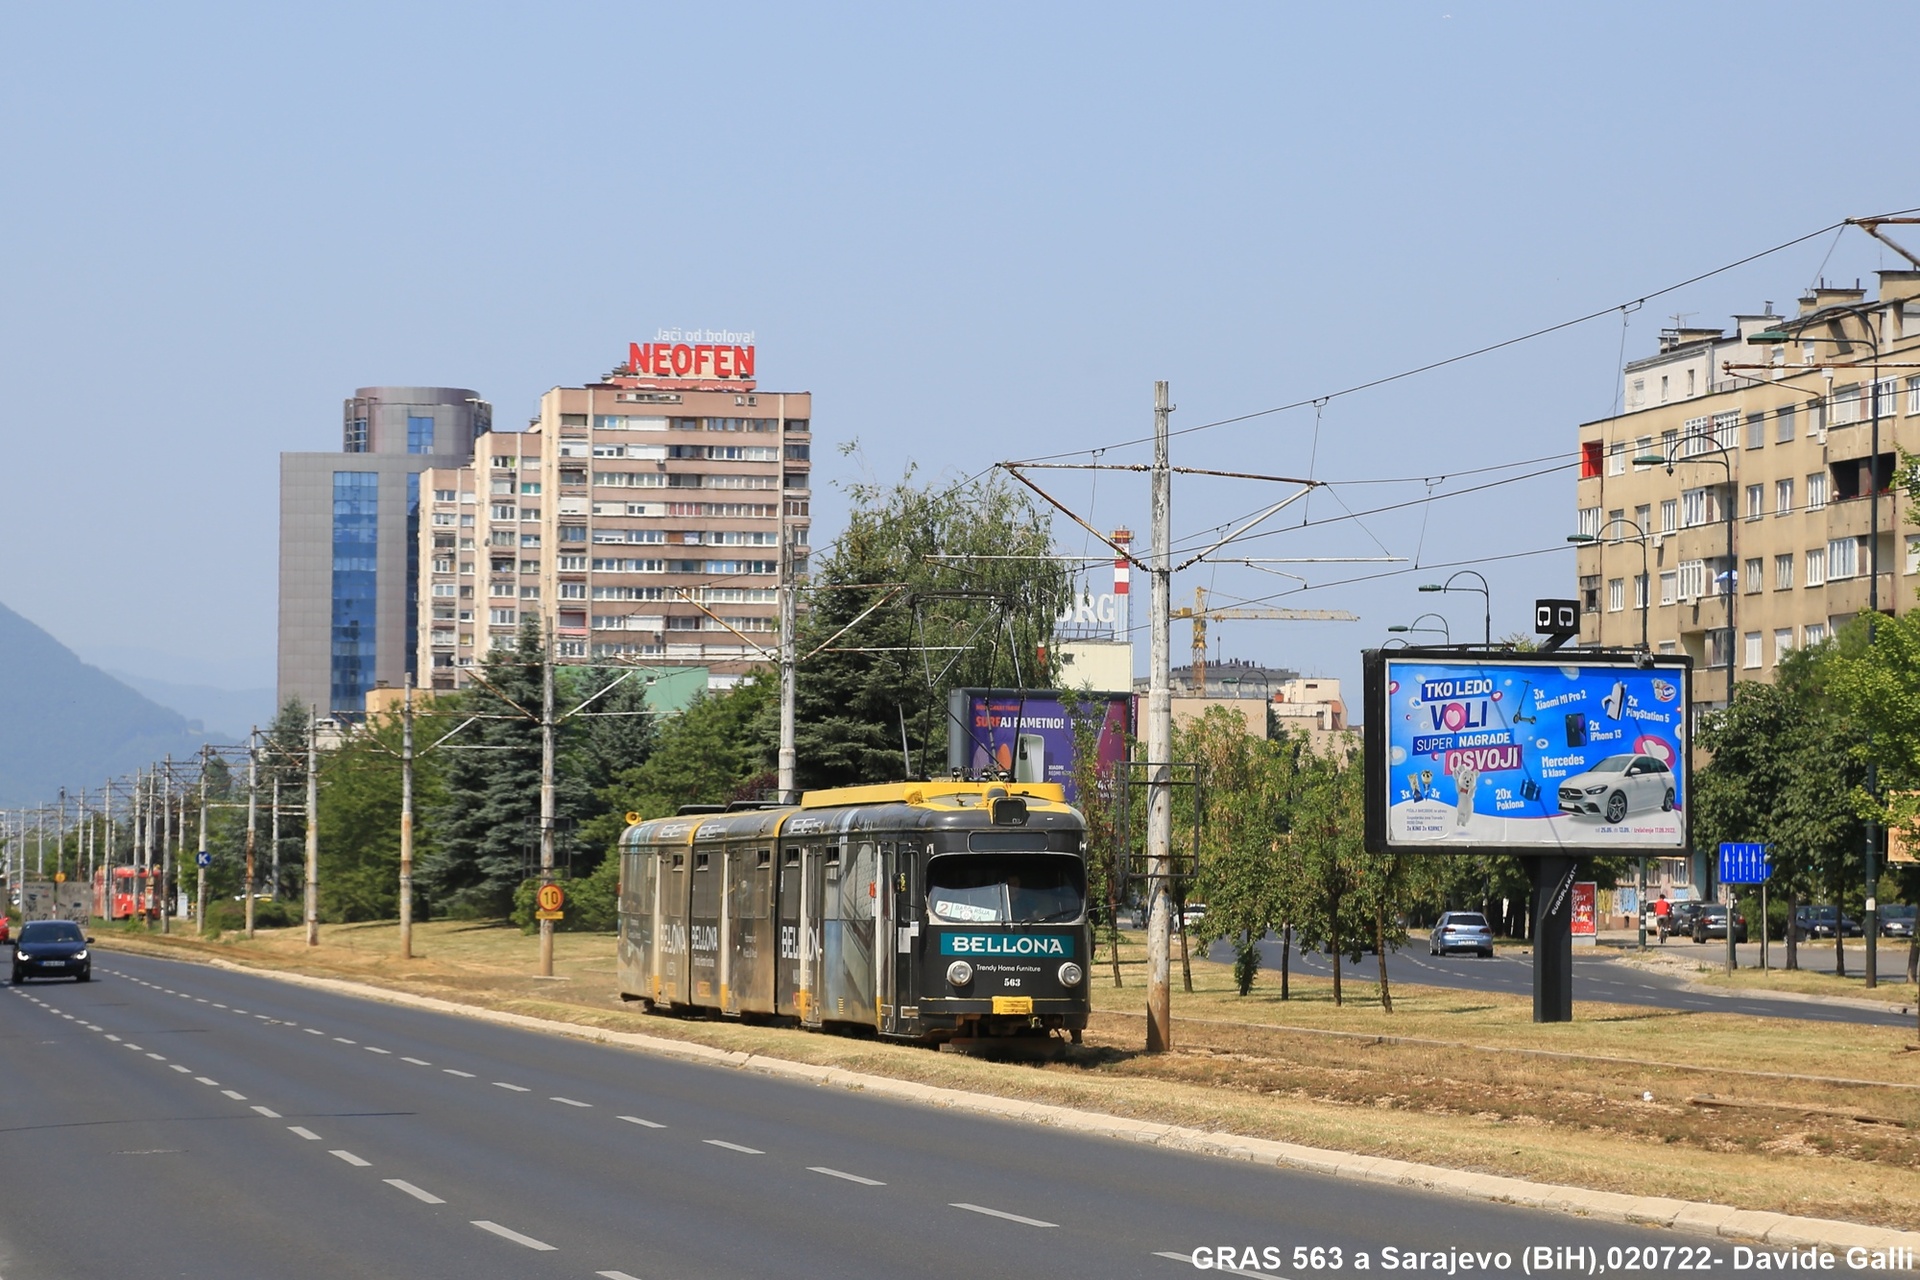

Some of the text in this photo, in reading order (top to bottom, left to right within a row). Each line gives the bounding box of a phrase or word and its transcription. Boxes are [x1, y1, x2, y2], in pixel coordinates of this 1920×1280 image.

[686, 329, 702, 342] od
[706, 329, 755, 343] bolova!
[629, 342, 755, 376] NEOFEN
[1425, 678, 1493, 698] TKO LEDO
[1533, 688, 1545, 700] 3x
[1536, 697, 1560, 711] Xiaomi
[1569, 692, 1580, 703] Pro
[1580, 690, 1587, 699] 2
[1627, 695, 1638, 707] 2x
[1430, 701, 1488, 731] VOLI
[1626, 707, 1670, 723] PlayStation 5
[975, 716, 1012, 728] SURFAJ
[1013, 717, 1064, 729] PAMETNO!
[1589, 720, 1600, 731] 2x
[1416, 732, 1511, 752] SUPER NAGRADE
[1590, 729, 1622, 742] iPhone 13
[1449, 747, 1518, 771] OSVOJI
[1541, 754, 1585, 768] Mercedes
[1542, 767, 1567, 778] B klase
[1400, 789, 1411, 799] 3x
[1431, 788, 1440, 799] 3x
[1495, 788, 1512, 800] 20x
[1496, 800, 1524, 811] Poklona
[199, 854, 208, 864] K
[544, 891, 559, 905] 10
[938, 903, 949, 915] 2
[952, 936, 1064, 954] BELLONA
[976, 964, 997, 972] Trendy
[1004, 978, 1021, 987] 563
